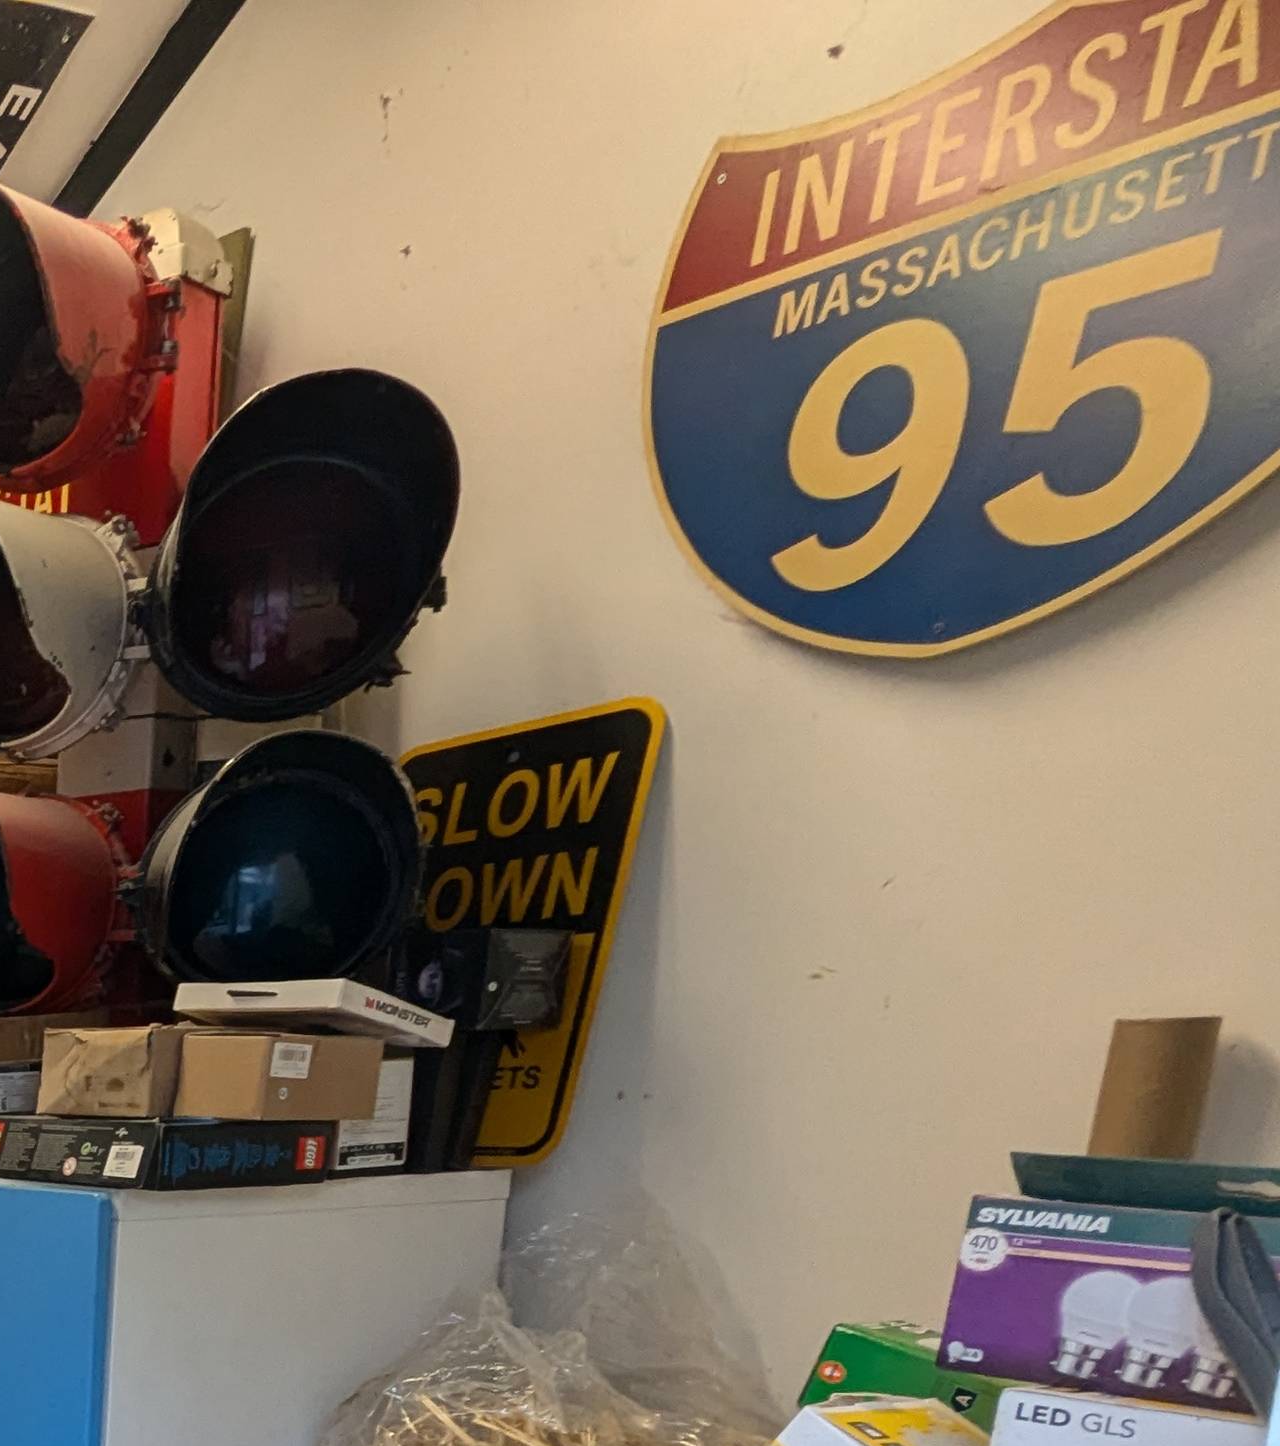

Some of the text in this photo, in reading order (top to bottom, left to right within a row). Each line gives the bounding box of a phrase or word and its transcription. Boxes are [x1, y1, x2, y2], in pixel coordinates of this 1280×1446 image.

[770, 228, 1223, 593] 95
[426, 848, 600, 934] OWN
[976, 1206, 1112, 1234] SYLVANIA
[968, 1235, 998, 1251] 470
[1015, 1402, 1137, 1439] LED GLS
